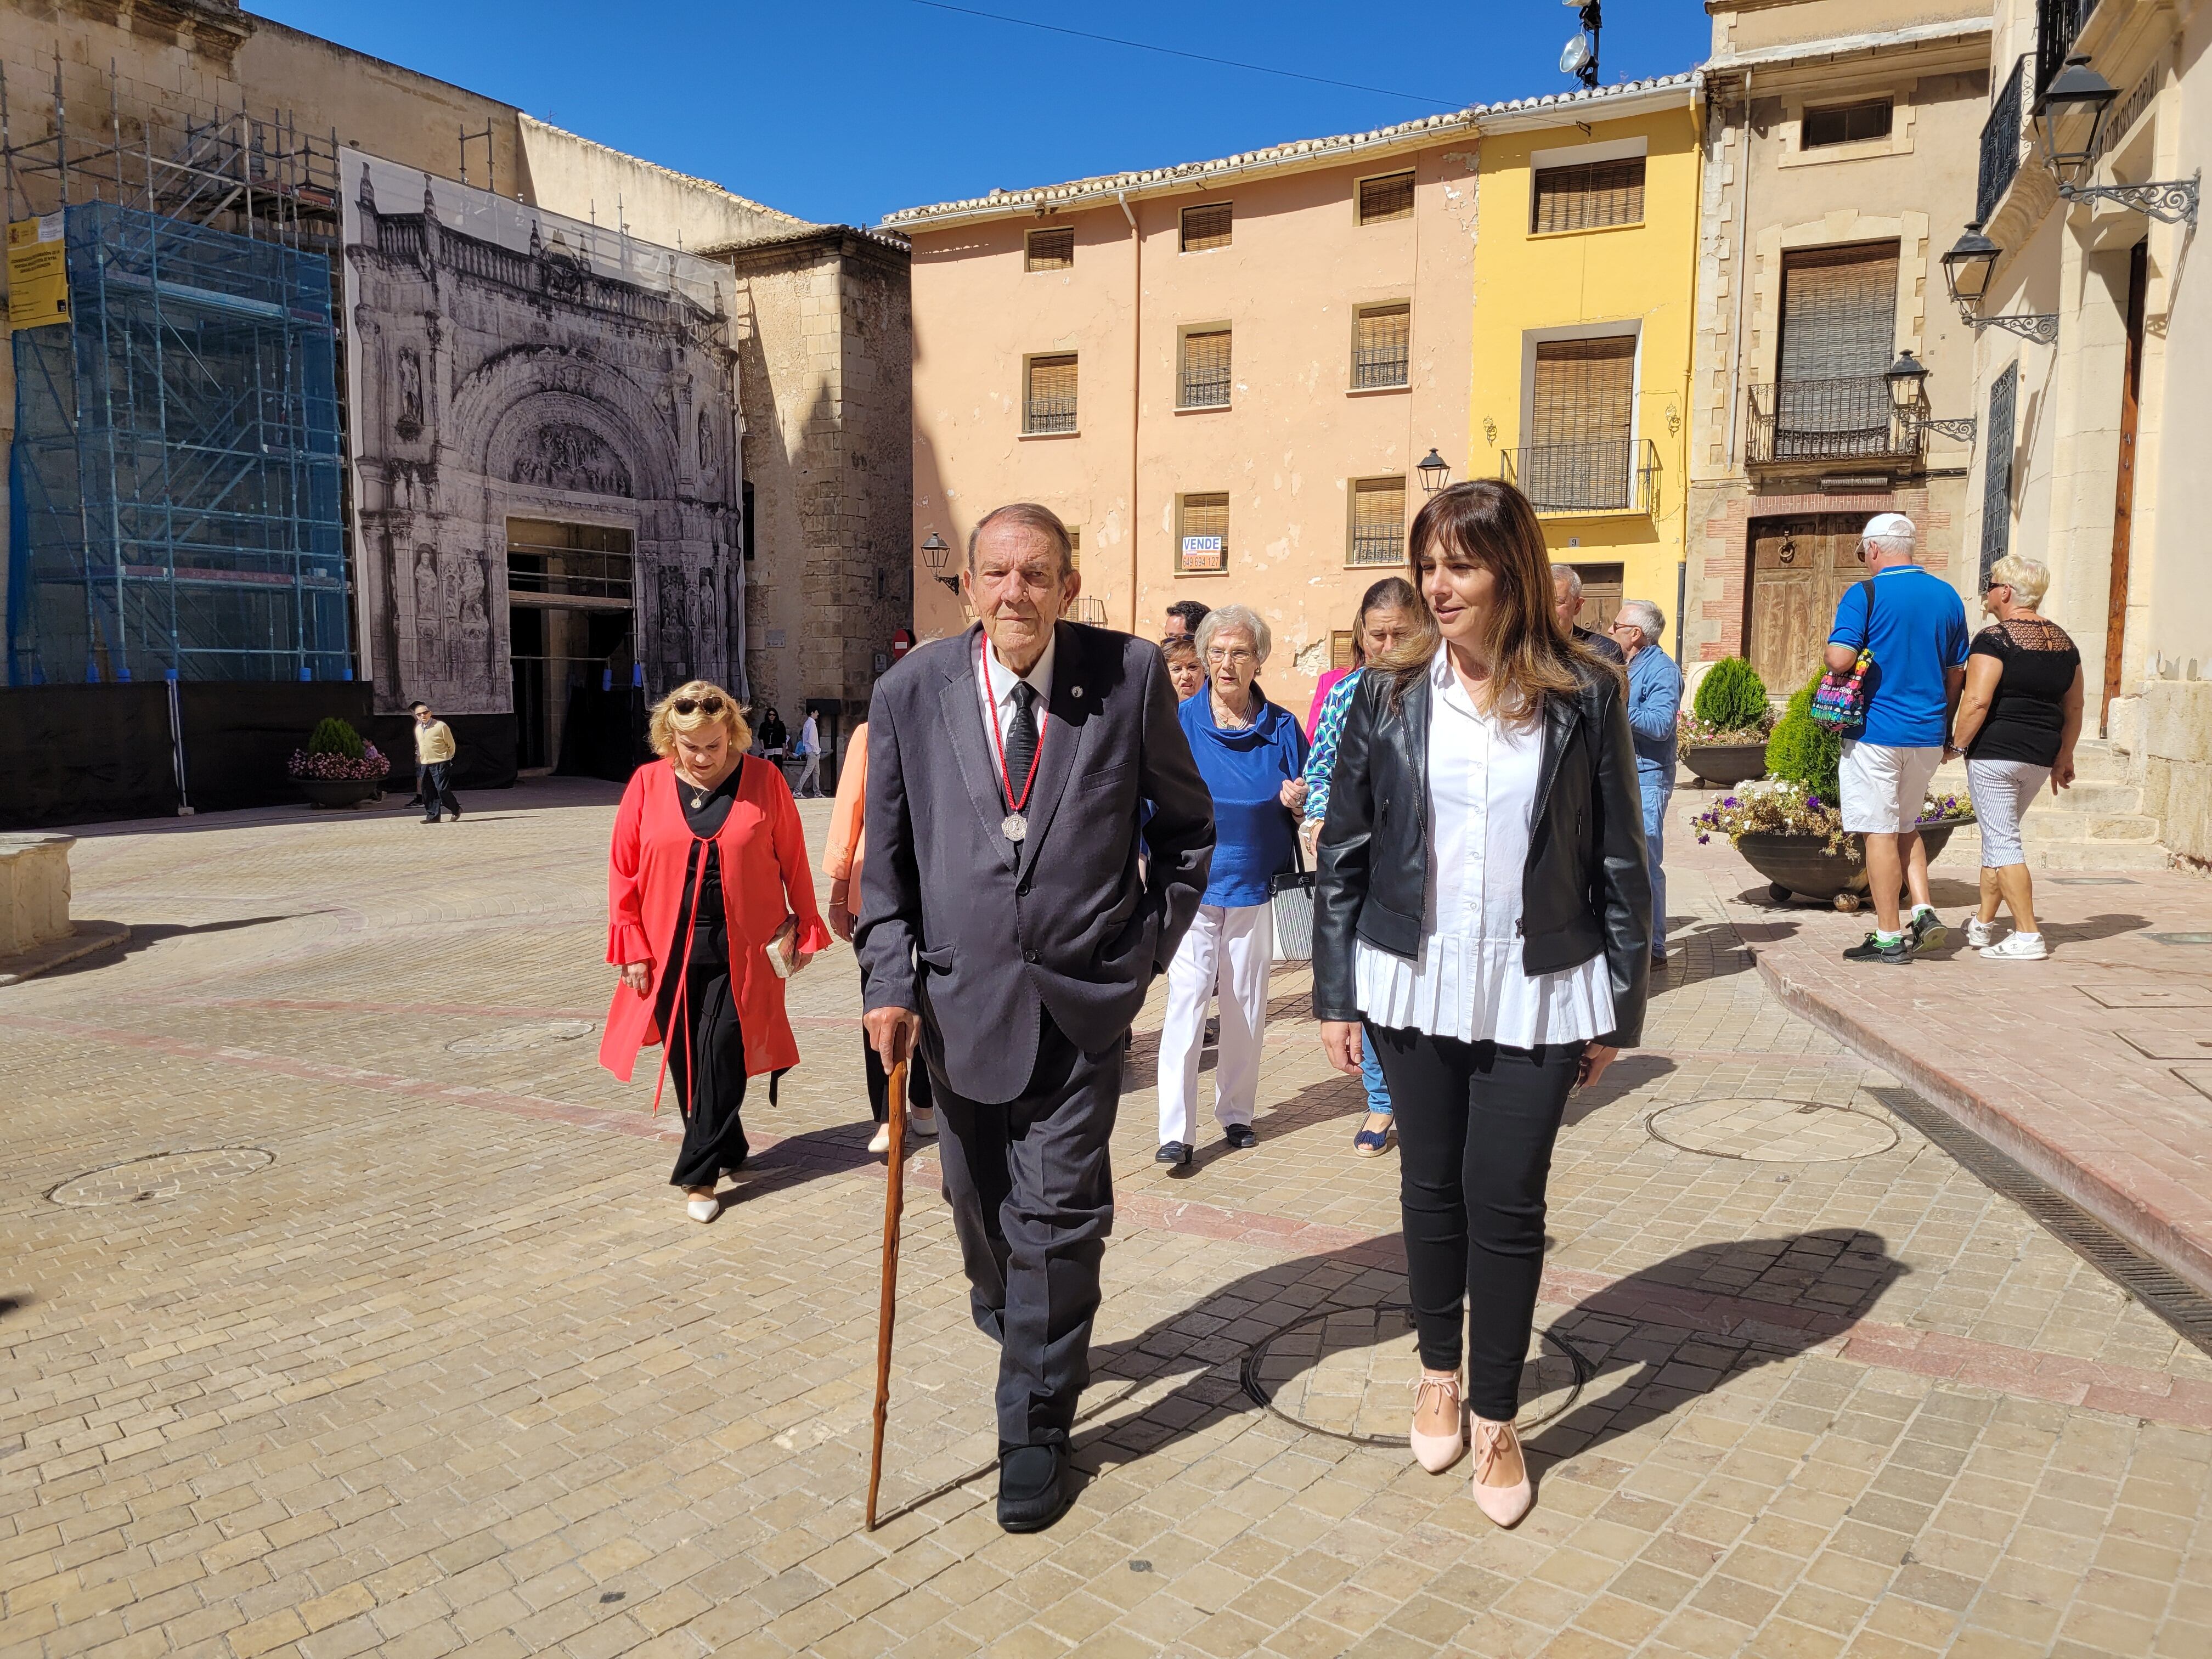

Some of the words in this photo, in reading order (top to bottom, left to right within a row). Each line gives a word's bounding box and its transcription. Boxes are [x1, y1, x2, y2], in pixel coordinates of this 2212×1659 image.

[1183, 538, 1219, 550] VENDE
[1572, 539, 1577, 547] 9
[1183, 557, 1193, 567] 649
[1194, 557, 1205, 567] 694
[1207, 556, 1219, 567] 127
